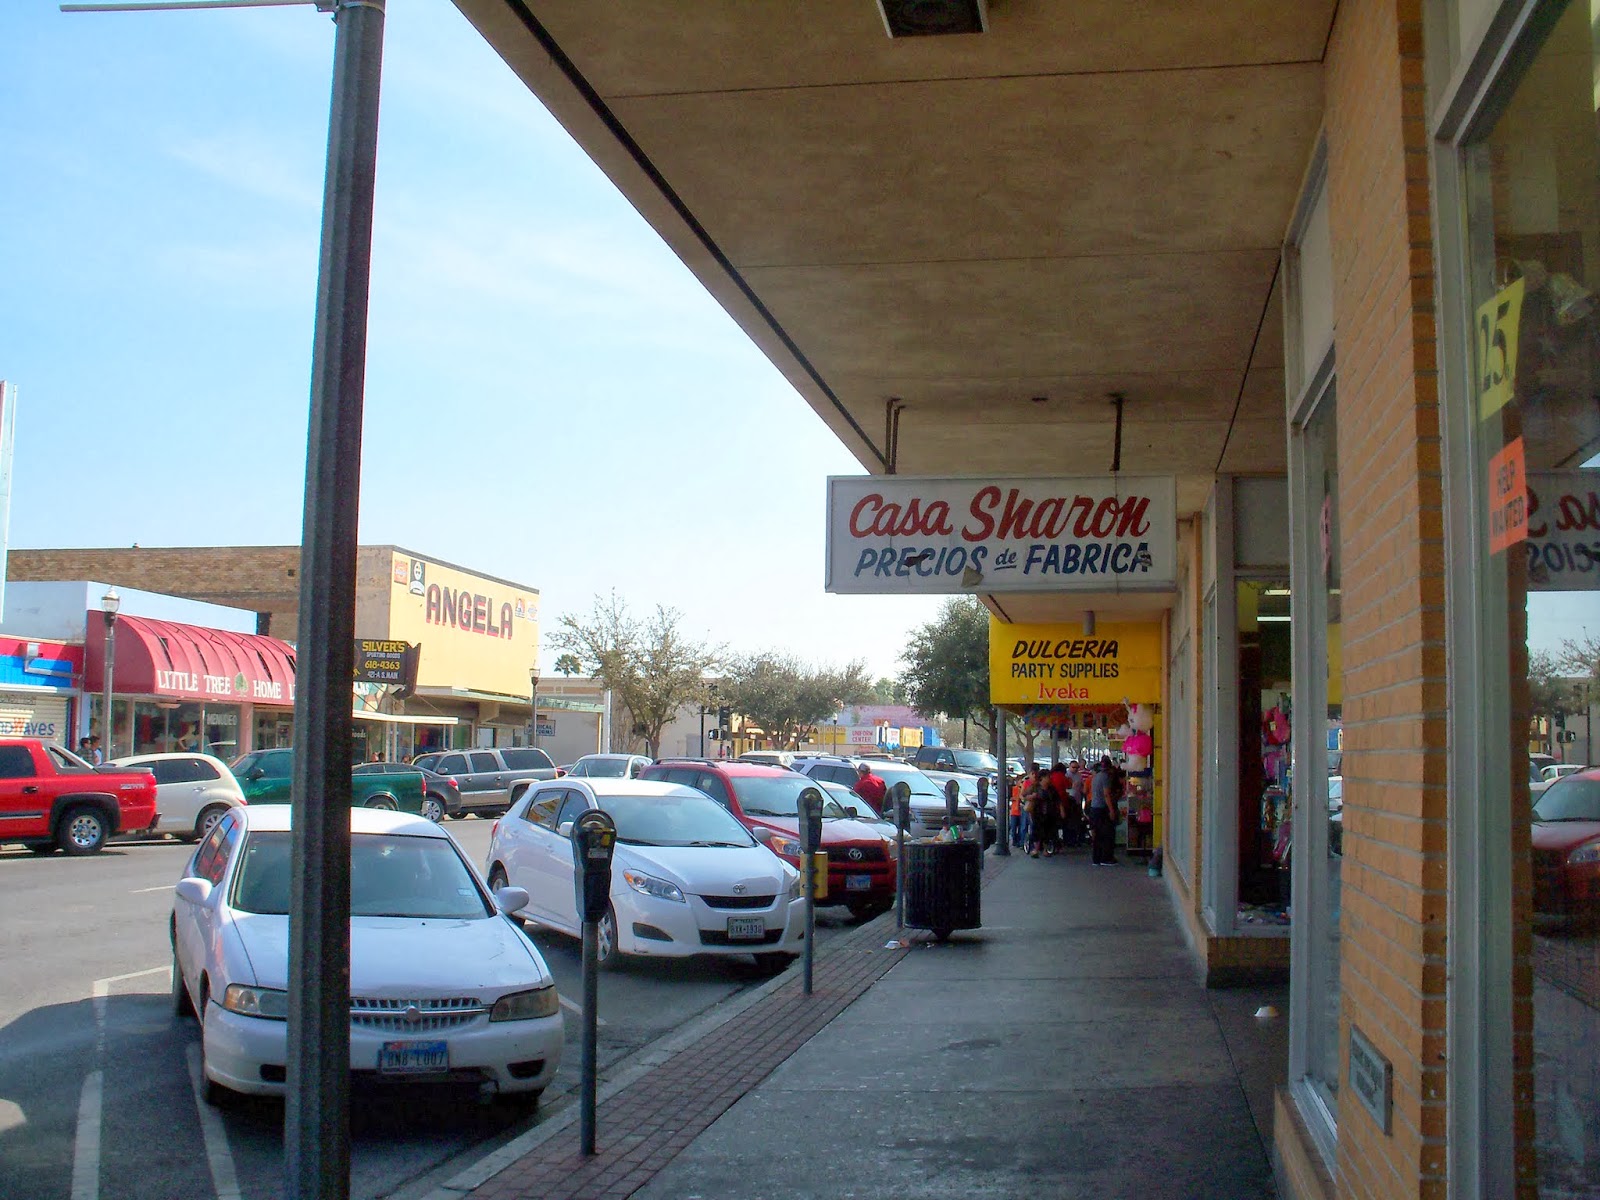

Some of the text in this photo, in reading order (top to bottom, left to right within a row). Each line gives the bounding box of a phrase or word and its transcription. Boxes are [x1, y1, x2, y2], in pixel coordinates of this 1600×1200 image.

[849, 485, 1151, 542] Casa Sharon
[853, 542, 1153, 578] PRECIOS de FABRICA
[425, 583, 514, 640] ANGELA
[362, 641, 405, 652] SILVER'S
[1012, 640, 1119, 659] DULCERIA
[1012, 662, 1119, 679] PARTY SUPPLIES
[156, 670, 198, 692] LITTLE
[203, 674, 232, 695] TREE
[253, 679, 282, 699] HOME
[1039, 683, 1089, 700] Iveka
